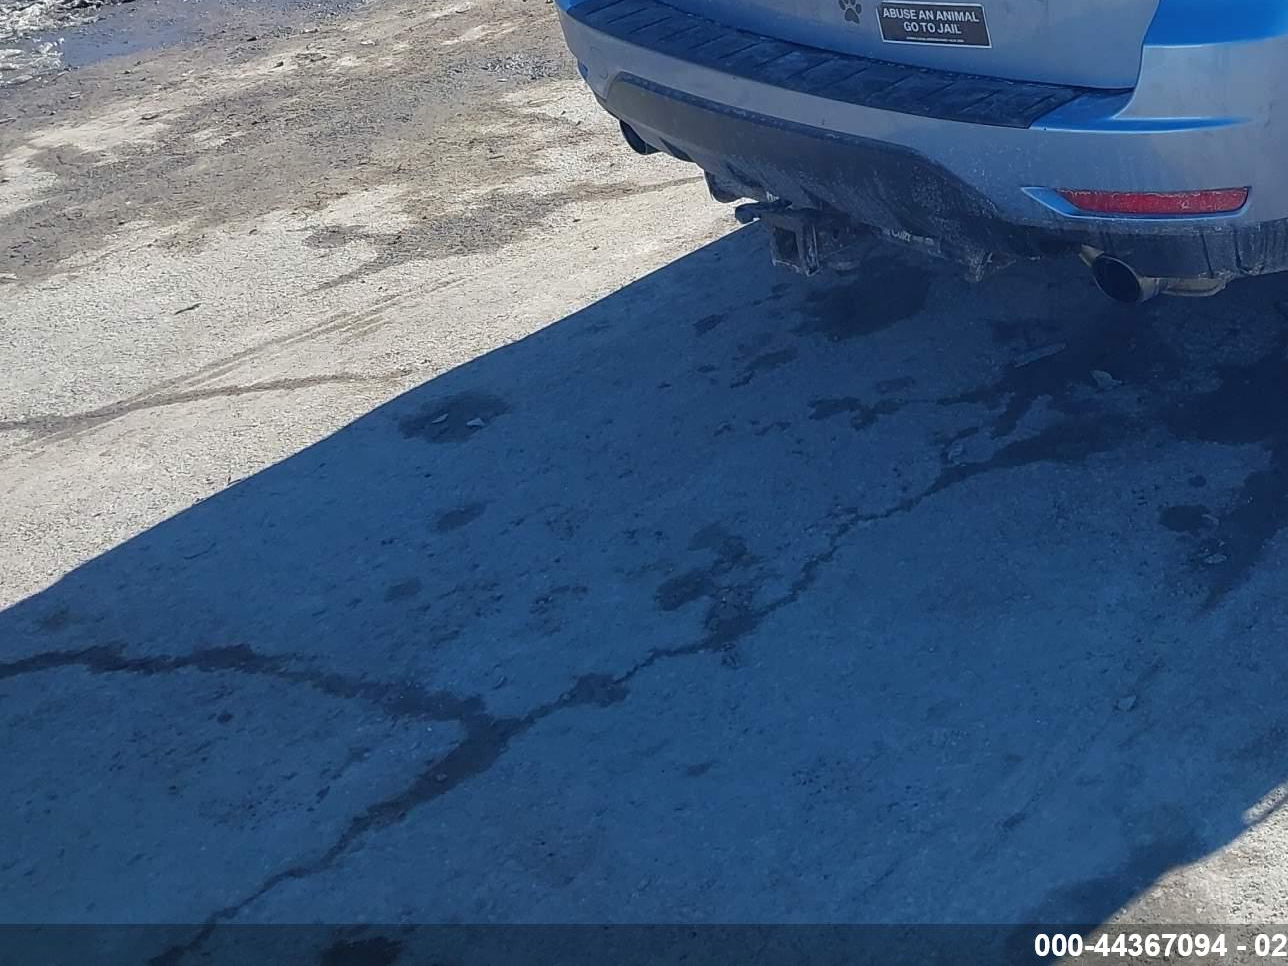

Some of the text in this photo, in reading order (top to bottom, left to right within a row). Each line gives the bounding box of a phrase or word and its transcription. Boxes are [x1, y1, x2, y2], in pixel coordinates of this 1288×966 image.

[883, 8, 980, 23] ABUSE AN ANIMAL
[903, 21, 962, 34] GO TO JAIL
